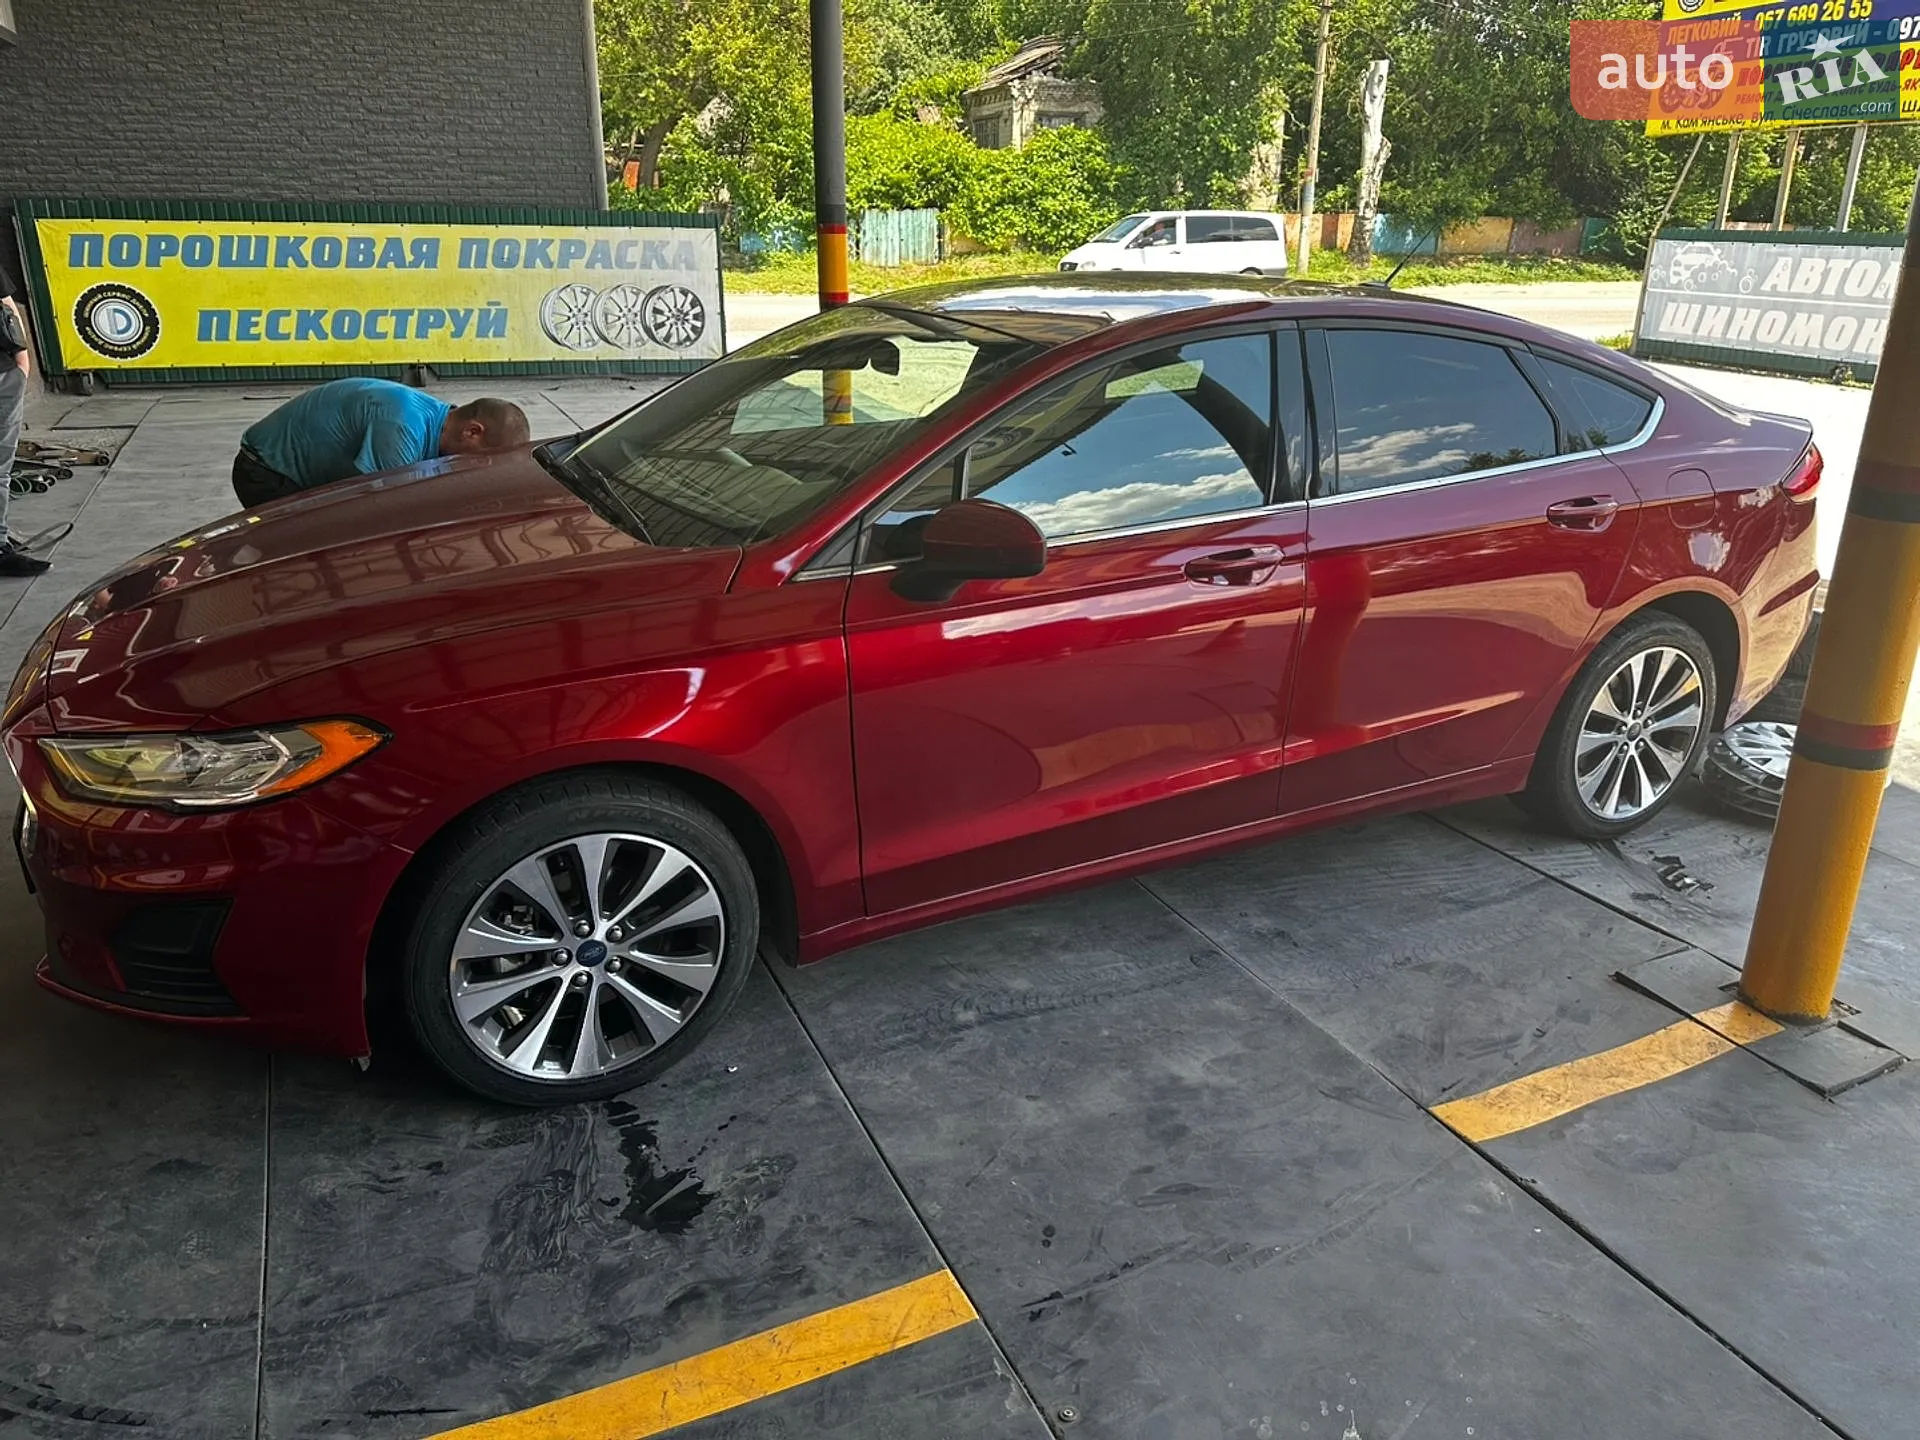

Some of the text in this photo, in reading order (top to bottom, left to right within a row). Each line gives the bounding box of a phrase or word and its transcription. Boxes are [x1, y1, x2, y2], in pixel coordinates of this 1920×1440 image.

[1665, 12, 1741, 46] ЛЕГКОВИЙ
[1753, 9, 1785, 32] 067
[1786, 3, 1818, 28] 689
[1820, 0, 1844, 21] 26
[1848, 0, 1873, 19] 55
[1745, 35, 1772, 59] TIR
[1867, 77, 1920, 94] БУДЬ-ЯК
[68, 233, 700, 271] ПОРОШКОВАЯ ПОКРАСКА
[197, 301, 509, 342] ПЕСКОСТРУЙ
